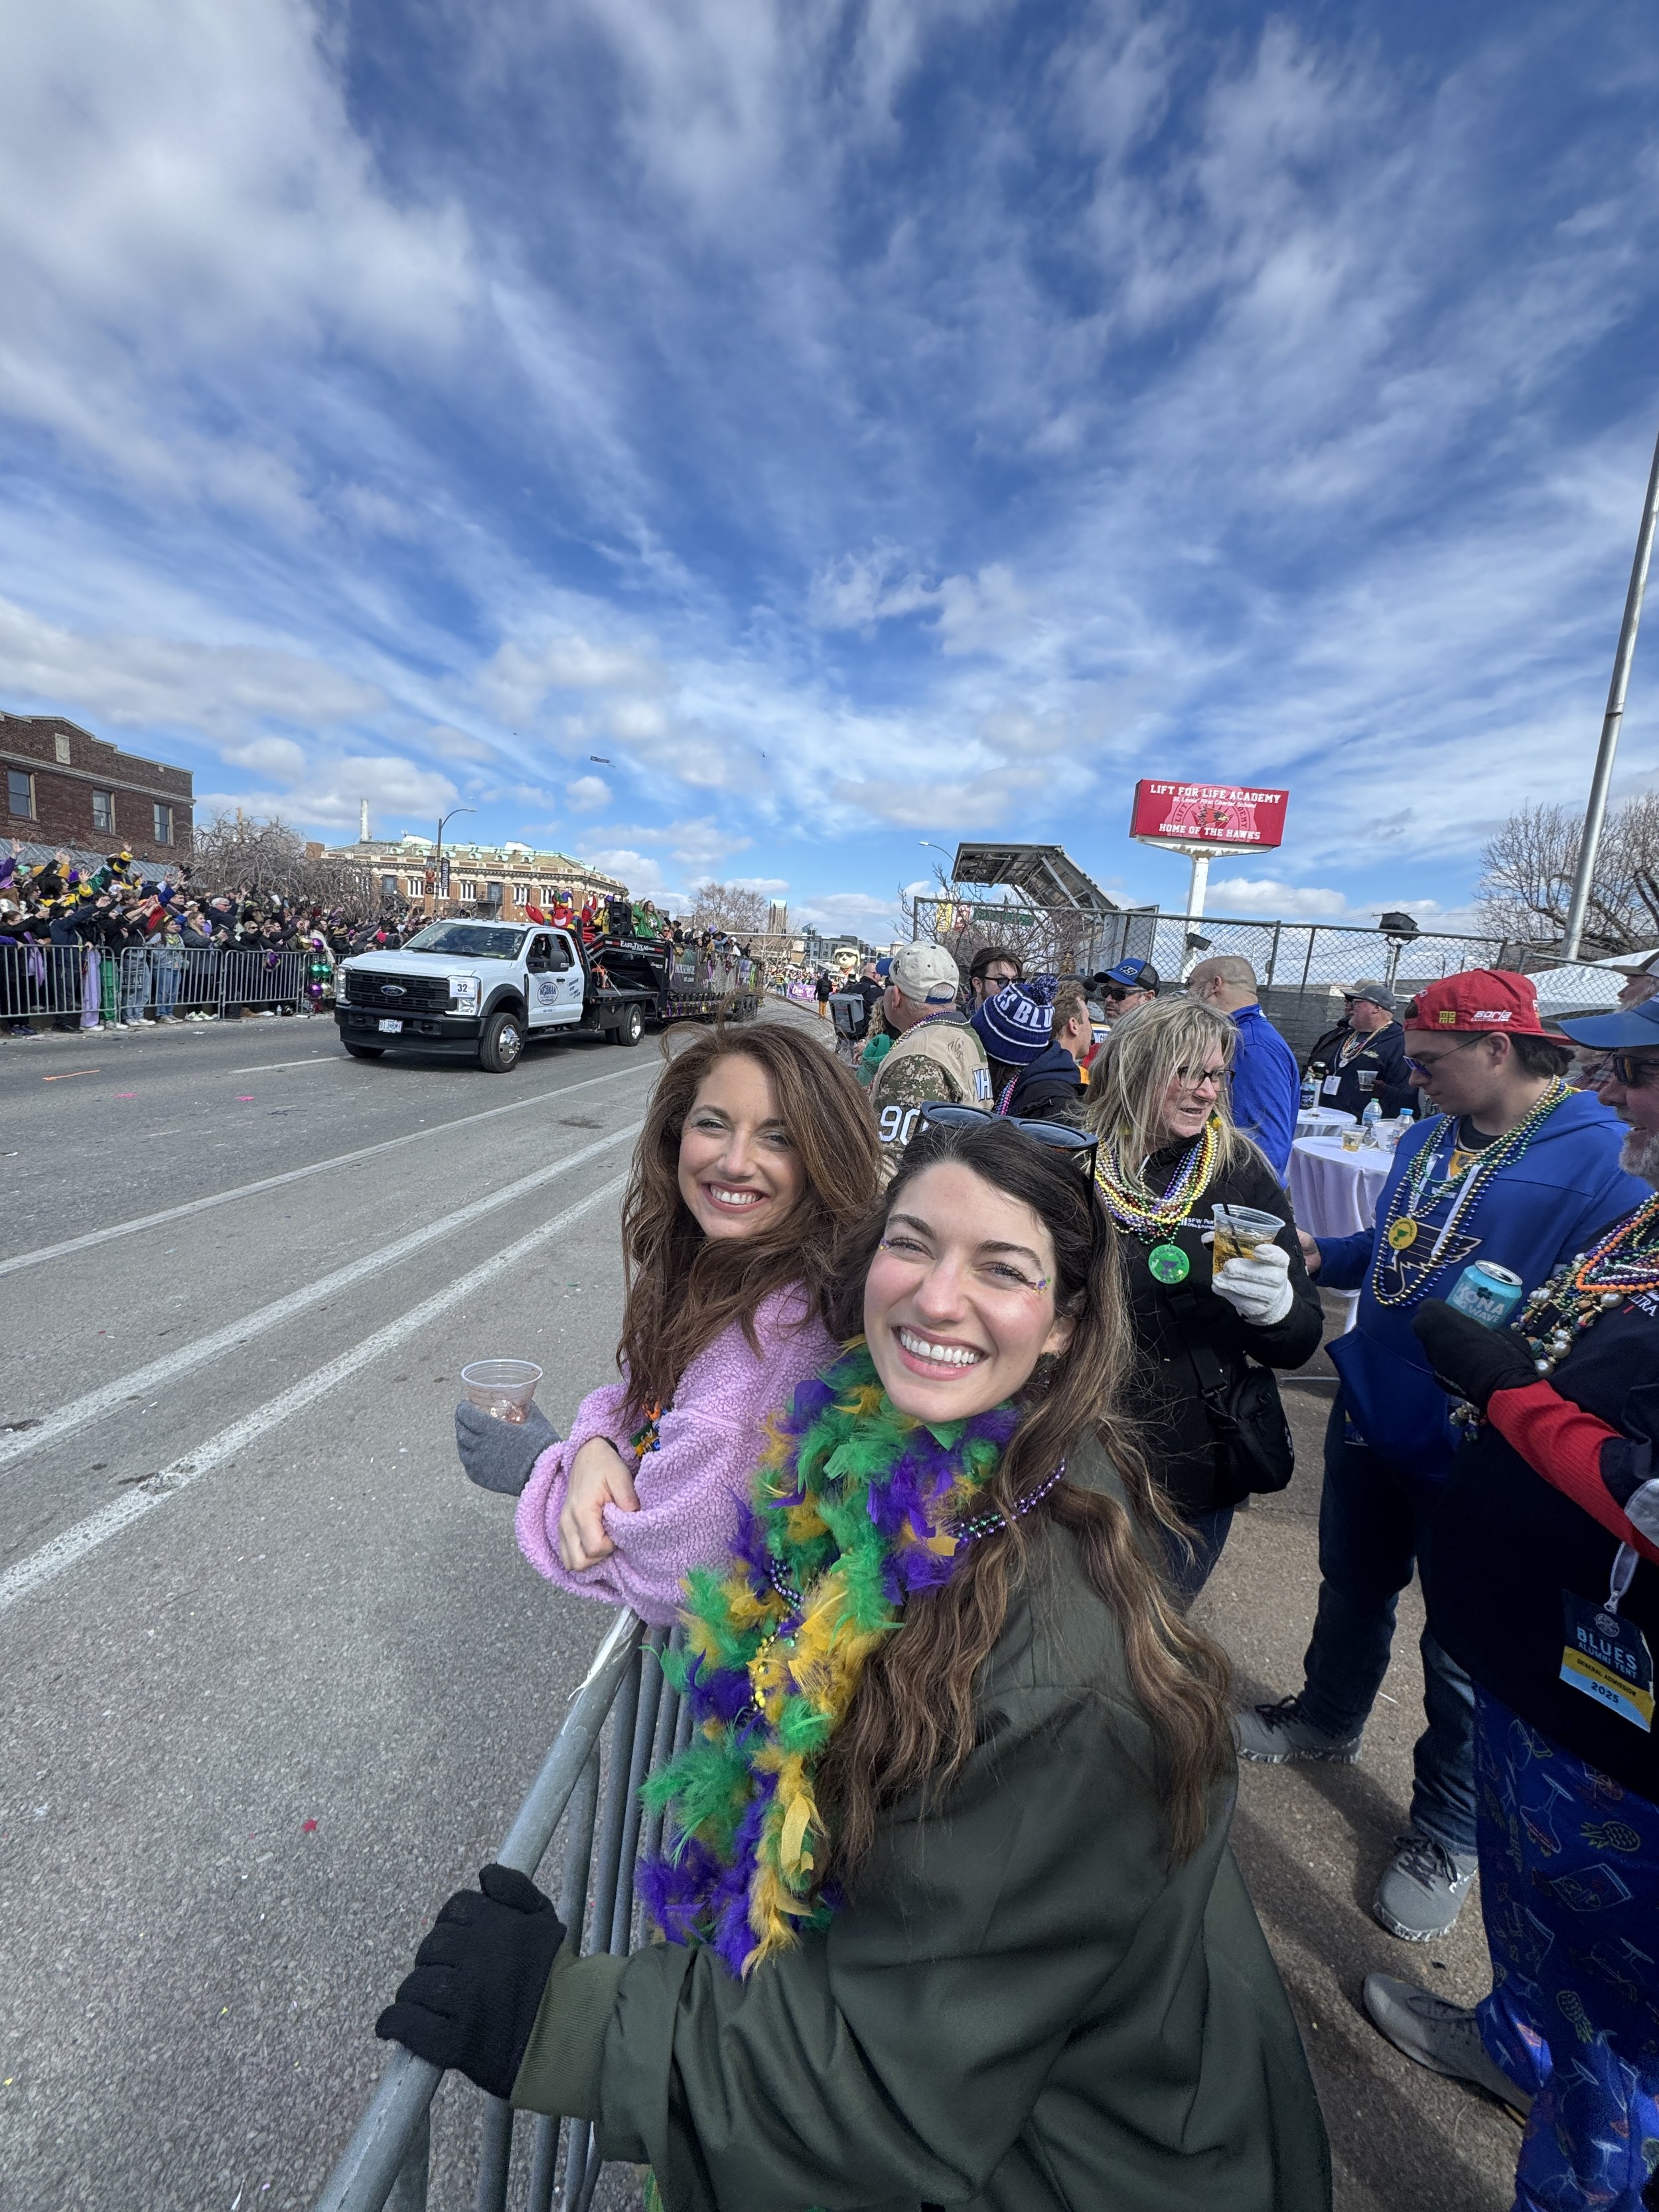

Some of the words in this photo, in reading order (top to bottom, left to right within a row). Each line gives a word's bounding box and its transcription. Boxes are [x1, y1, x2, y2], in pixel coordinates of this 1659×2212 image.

[1150, 784, 1175, 795] LIFT
[1177, 786, 1198, 796] FOR
[1202, 788, 1226, 799] LIFE
[1229, 791, 1281, 804] ACADEMY
[1175, 803, 1187, 822] LIFT
[1159, 823, 1187, 834] HOME
[1189, 826, 1201, 835] OF
[1204, 827, 1224, 837] THE
[1226, 829, 1261, 840] HAWKS
[457, 984, 468, 993] 32
[1469, 1305, 1502, 1323] WAVE
[1577, 1626, 1638, 1671] BLUES
[1578, 1641, 1611, 1665] ALUMNI
[1614, 1660, 1638, 1679] TENT
[1576, 1658, 1603, 1678] GENERAL
[1604, 1674, 1637, 1698] ADMISSION
[1591, 1681, 1620, 1704] 2025
